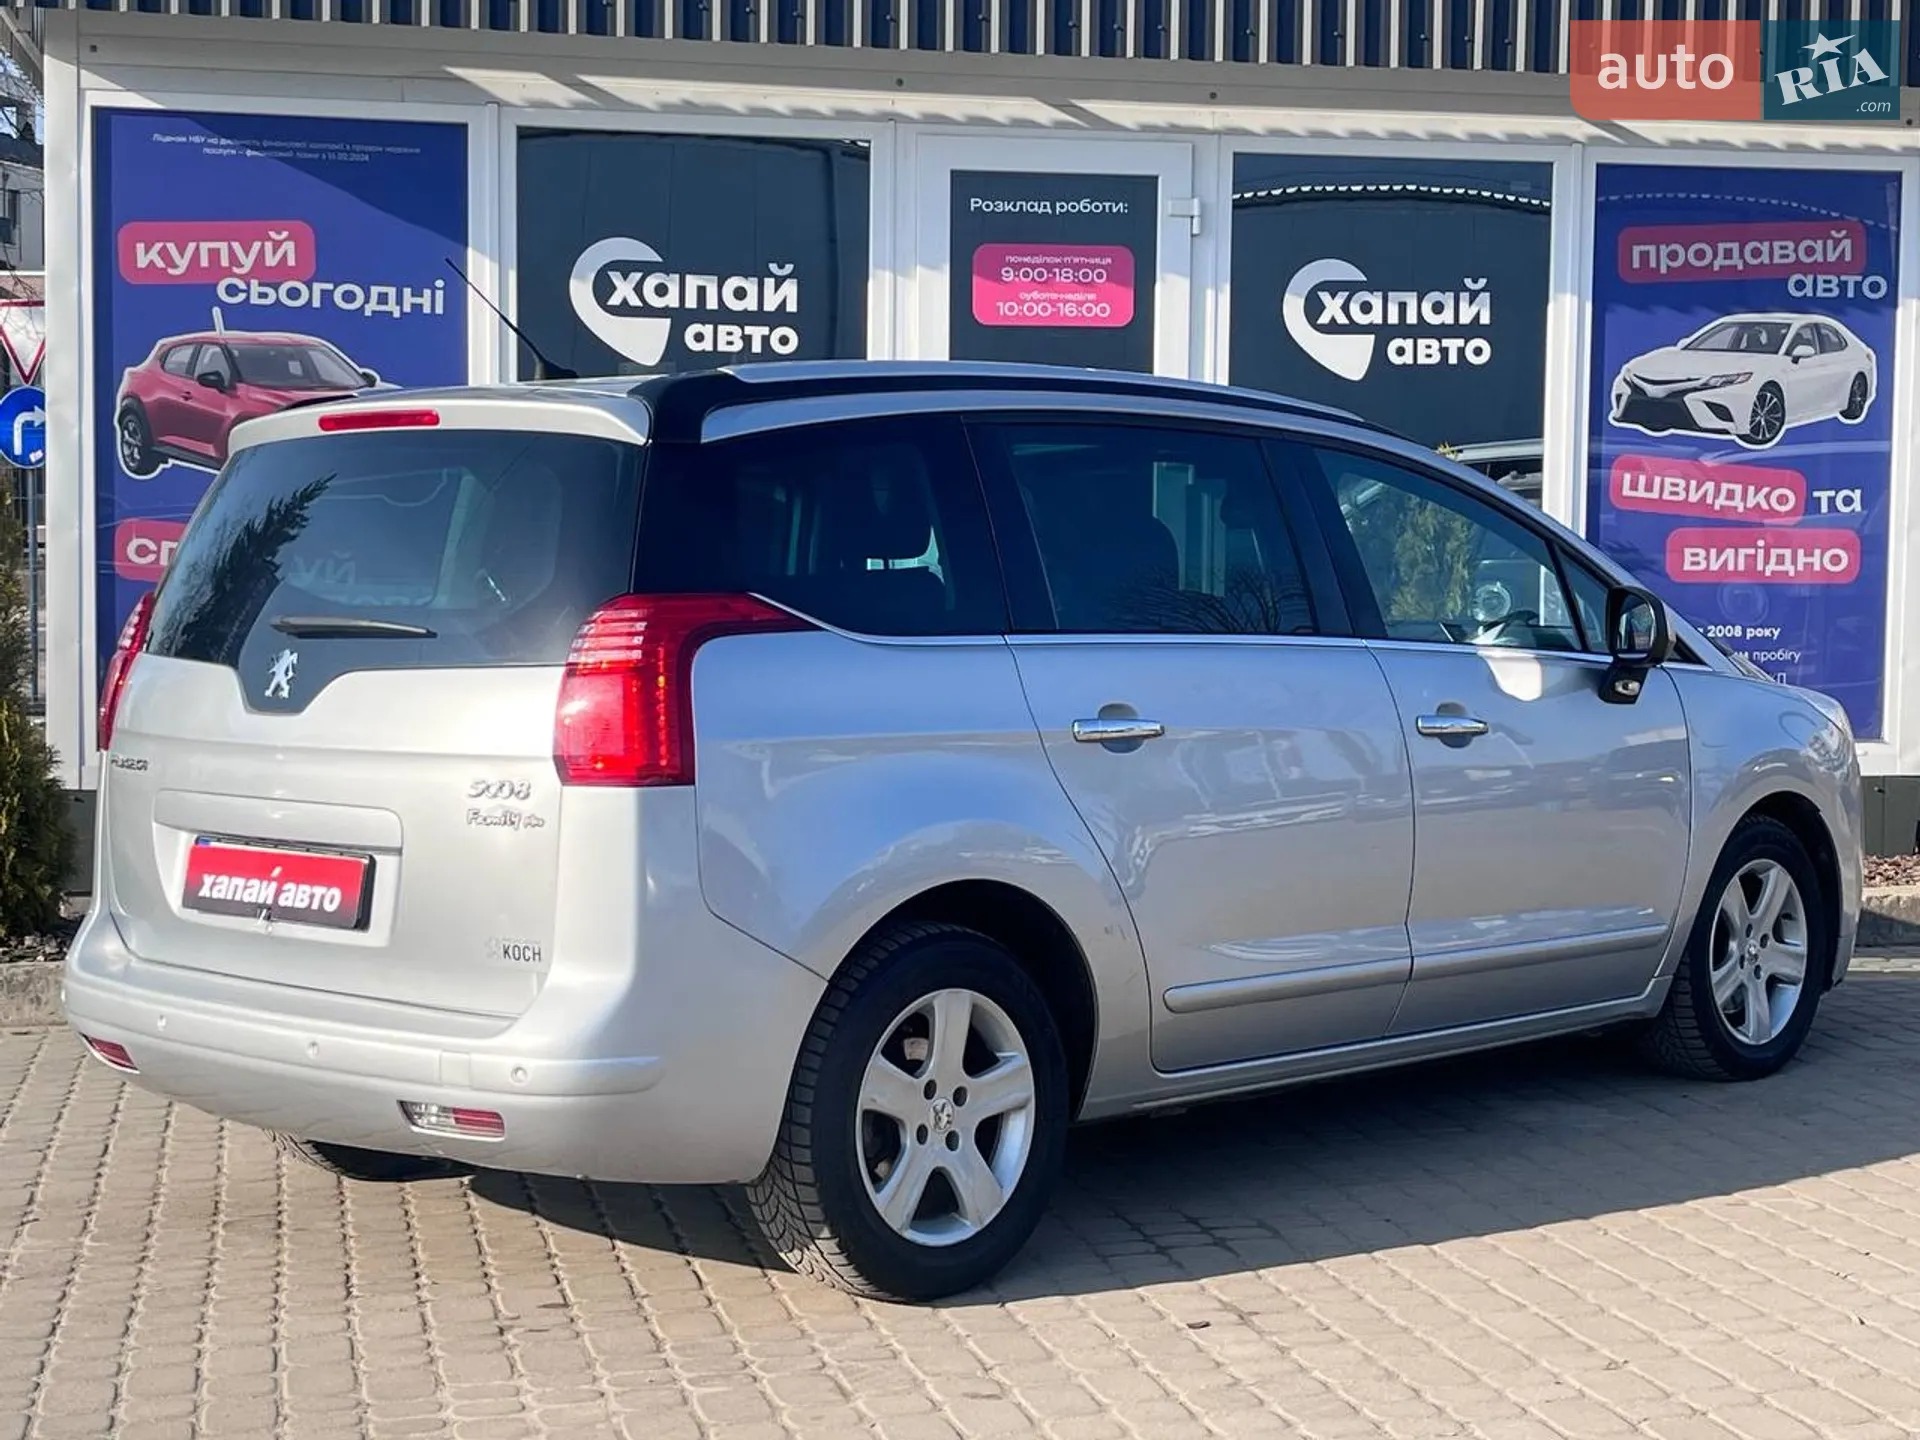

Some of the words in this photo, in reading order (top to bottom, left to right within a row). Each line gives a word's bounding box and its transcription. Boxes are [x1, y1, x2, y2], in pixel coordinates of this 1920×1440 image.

[970, 197, 1052, 215] Розклад
[1056, 198, 1129, 216] роботи:
[134, 230, 297, 276] купуй
[1631, 229, 1853, 275] продавай
[606, 262, 799, 313] хапай
[1000, 266, 1107, 283] 9:00-18:00
[1787, 273, 1888, 300] авто
[216, 277, 445, 319] сьогодні
[995, 301, 1112, 318] 10:00-16:00
[1316, 277, 1492, 325] хапай
[684, 322, 800, 355] авто
[1386, 337, 1492, 366] авто
[1621, 472, 1797, 513] швидко
[1812, 488, 1863, 514] та
[1682, 539, 1850, 577] вигідно
[1706, 624, 1743, 638] 2008
[1745, 626, 1782, 641] року
[1752, 647, 1802, 664] пробігу
[277, 882, 342, 913] авто
[502, 943, 542, 962] KOCH
